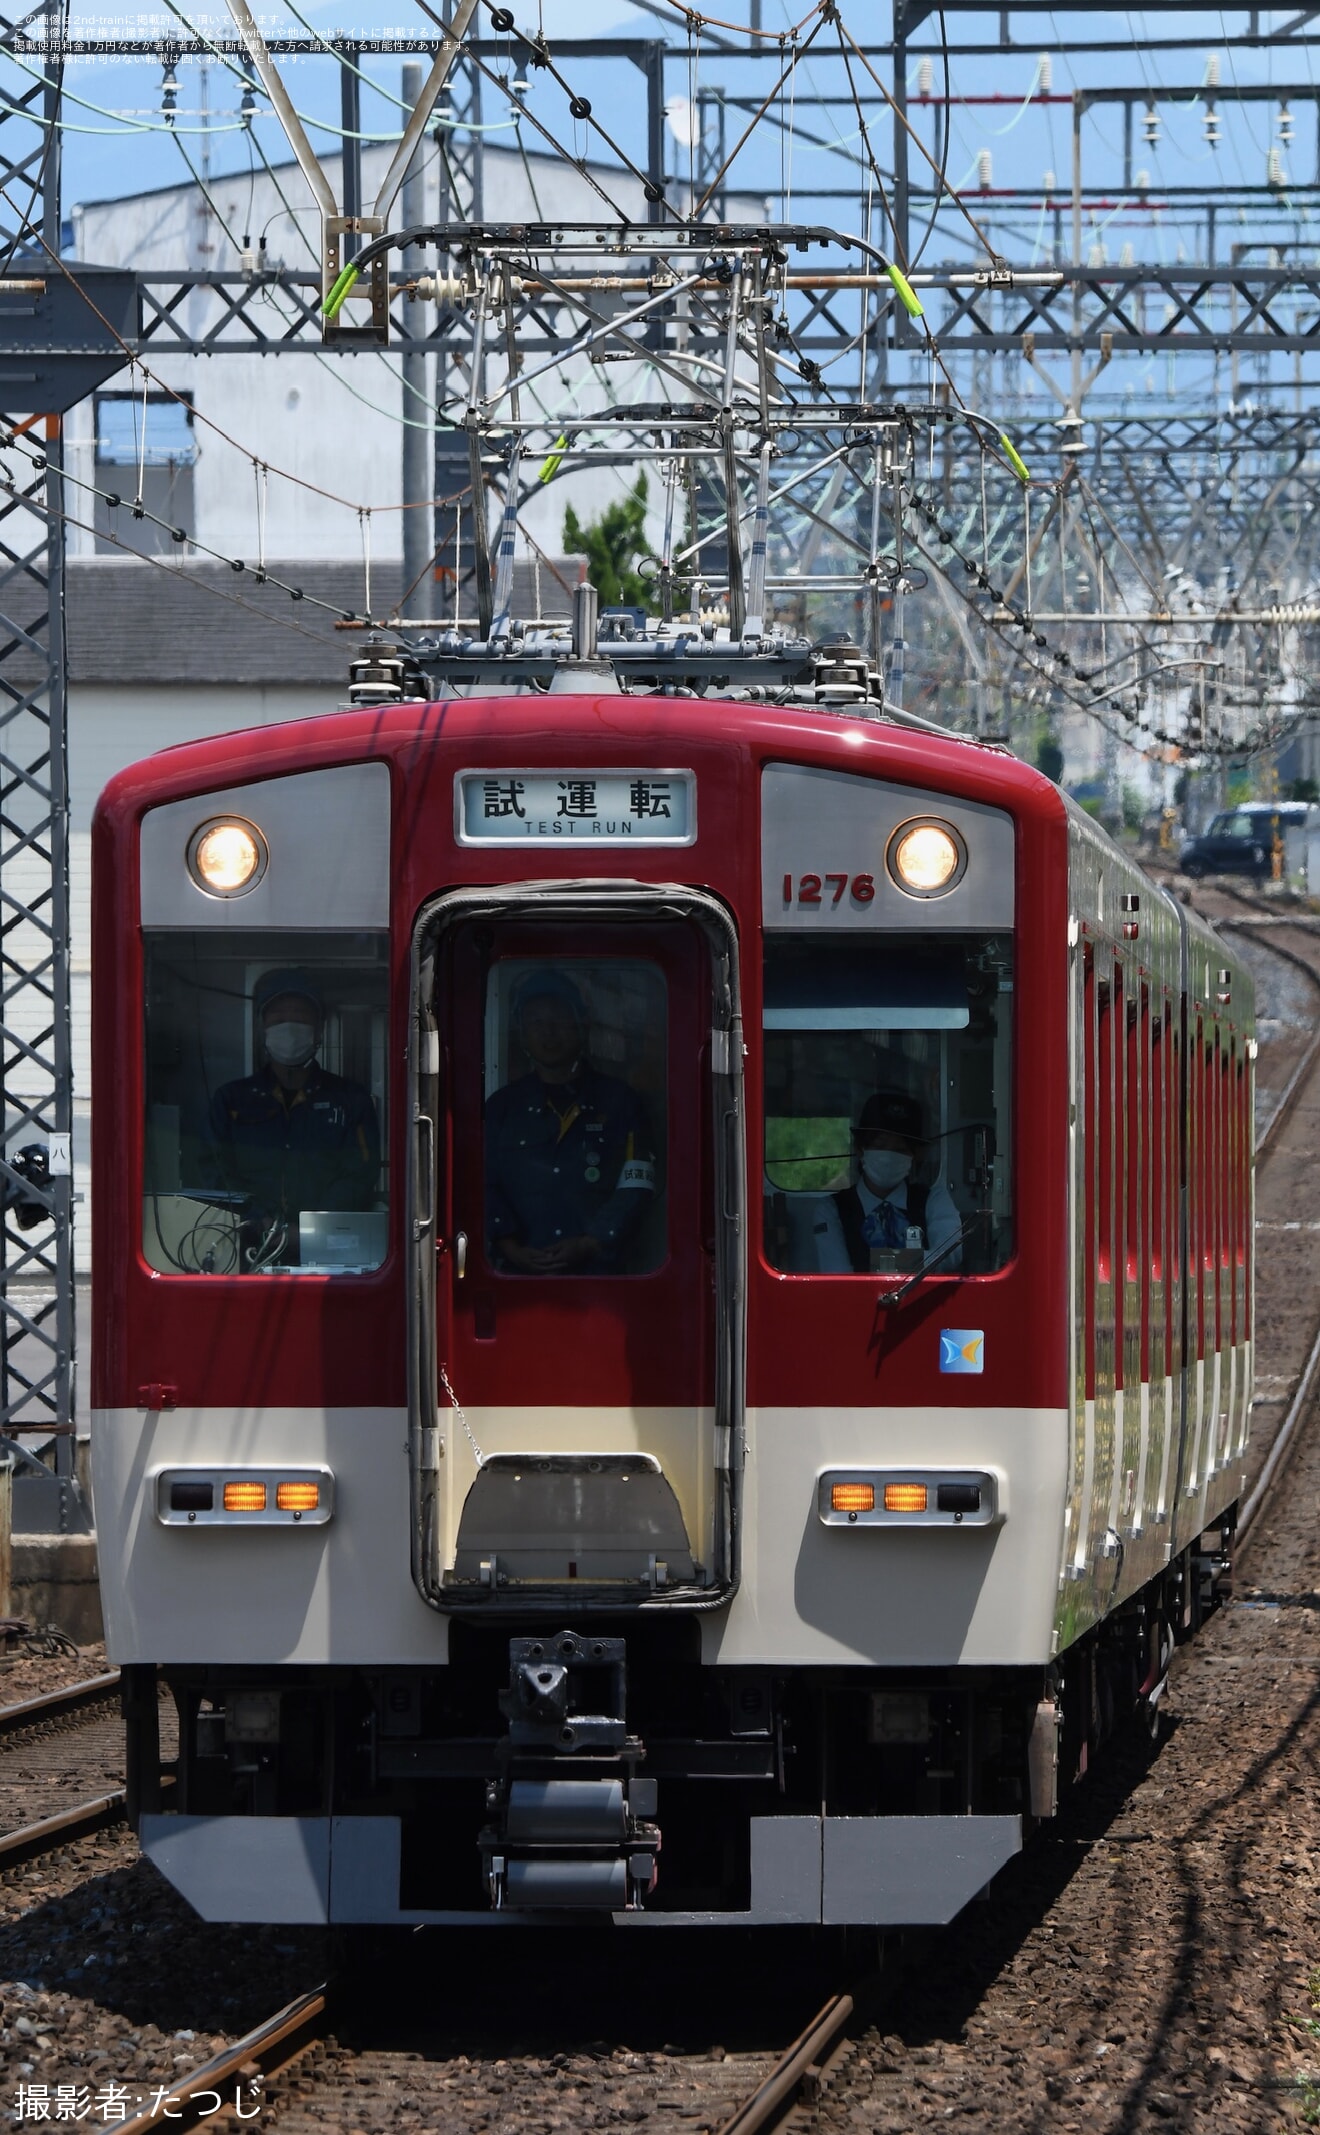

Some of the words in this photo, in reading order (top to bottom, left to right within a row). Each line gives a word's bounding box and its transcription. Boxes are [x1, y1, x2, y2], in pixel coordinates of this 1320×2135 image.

[483, 779, 671, 818] 試運転
[524, 821, 576, 834] TEST
[592, 821, 631, 834] RUN
[783, 873, 876, 902] 1276
